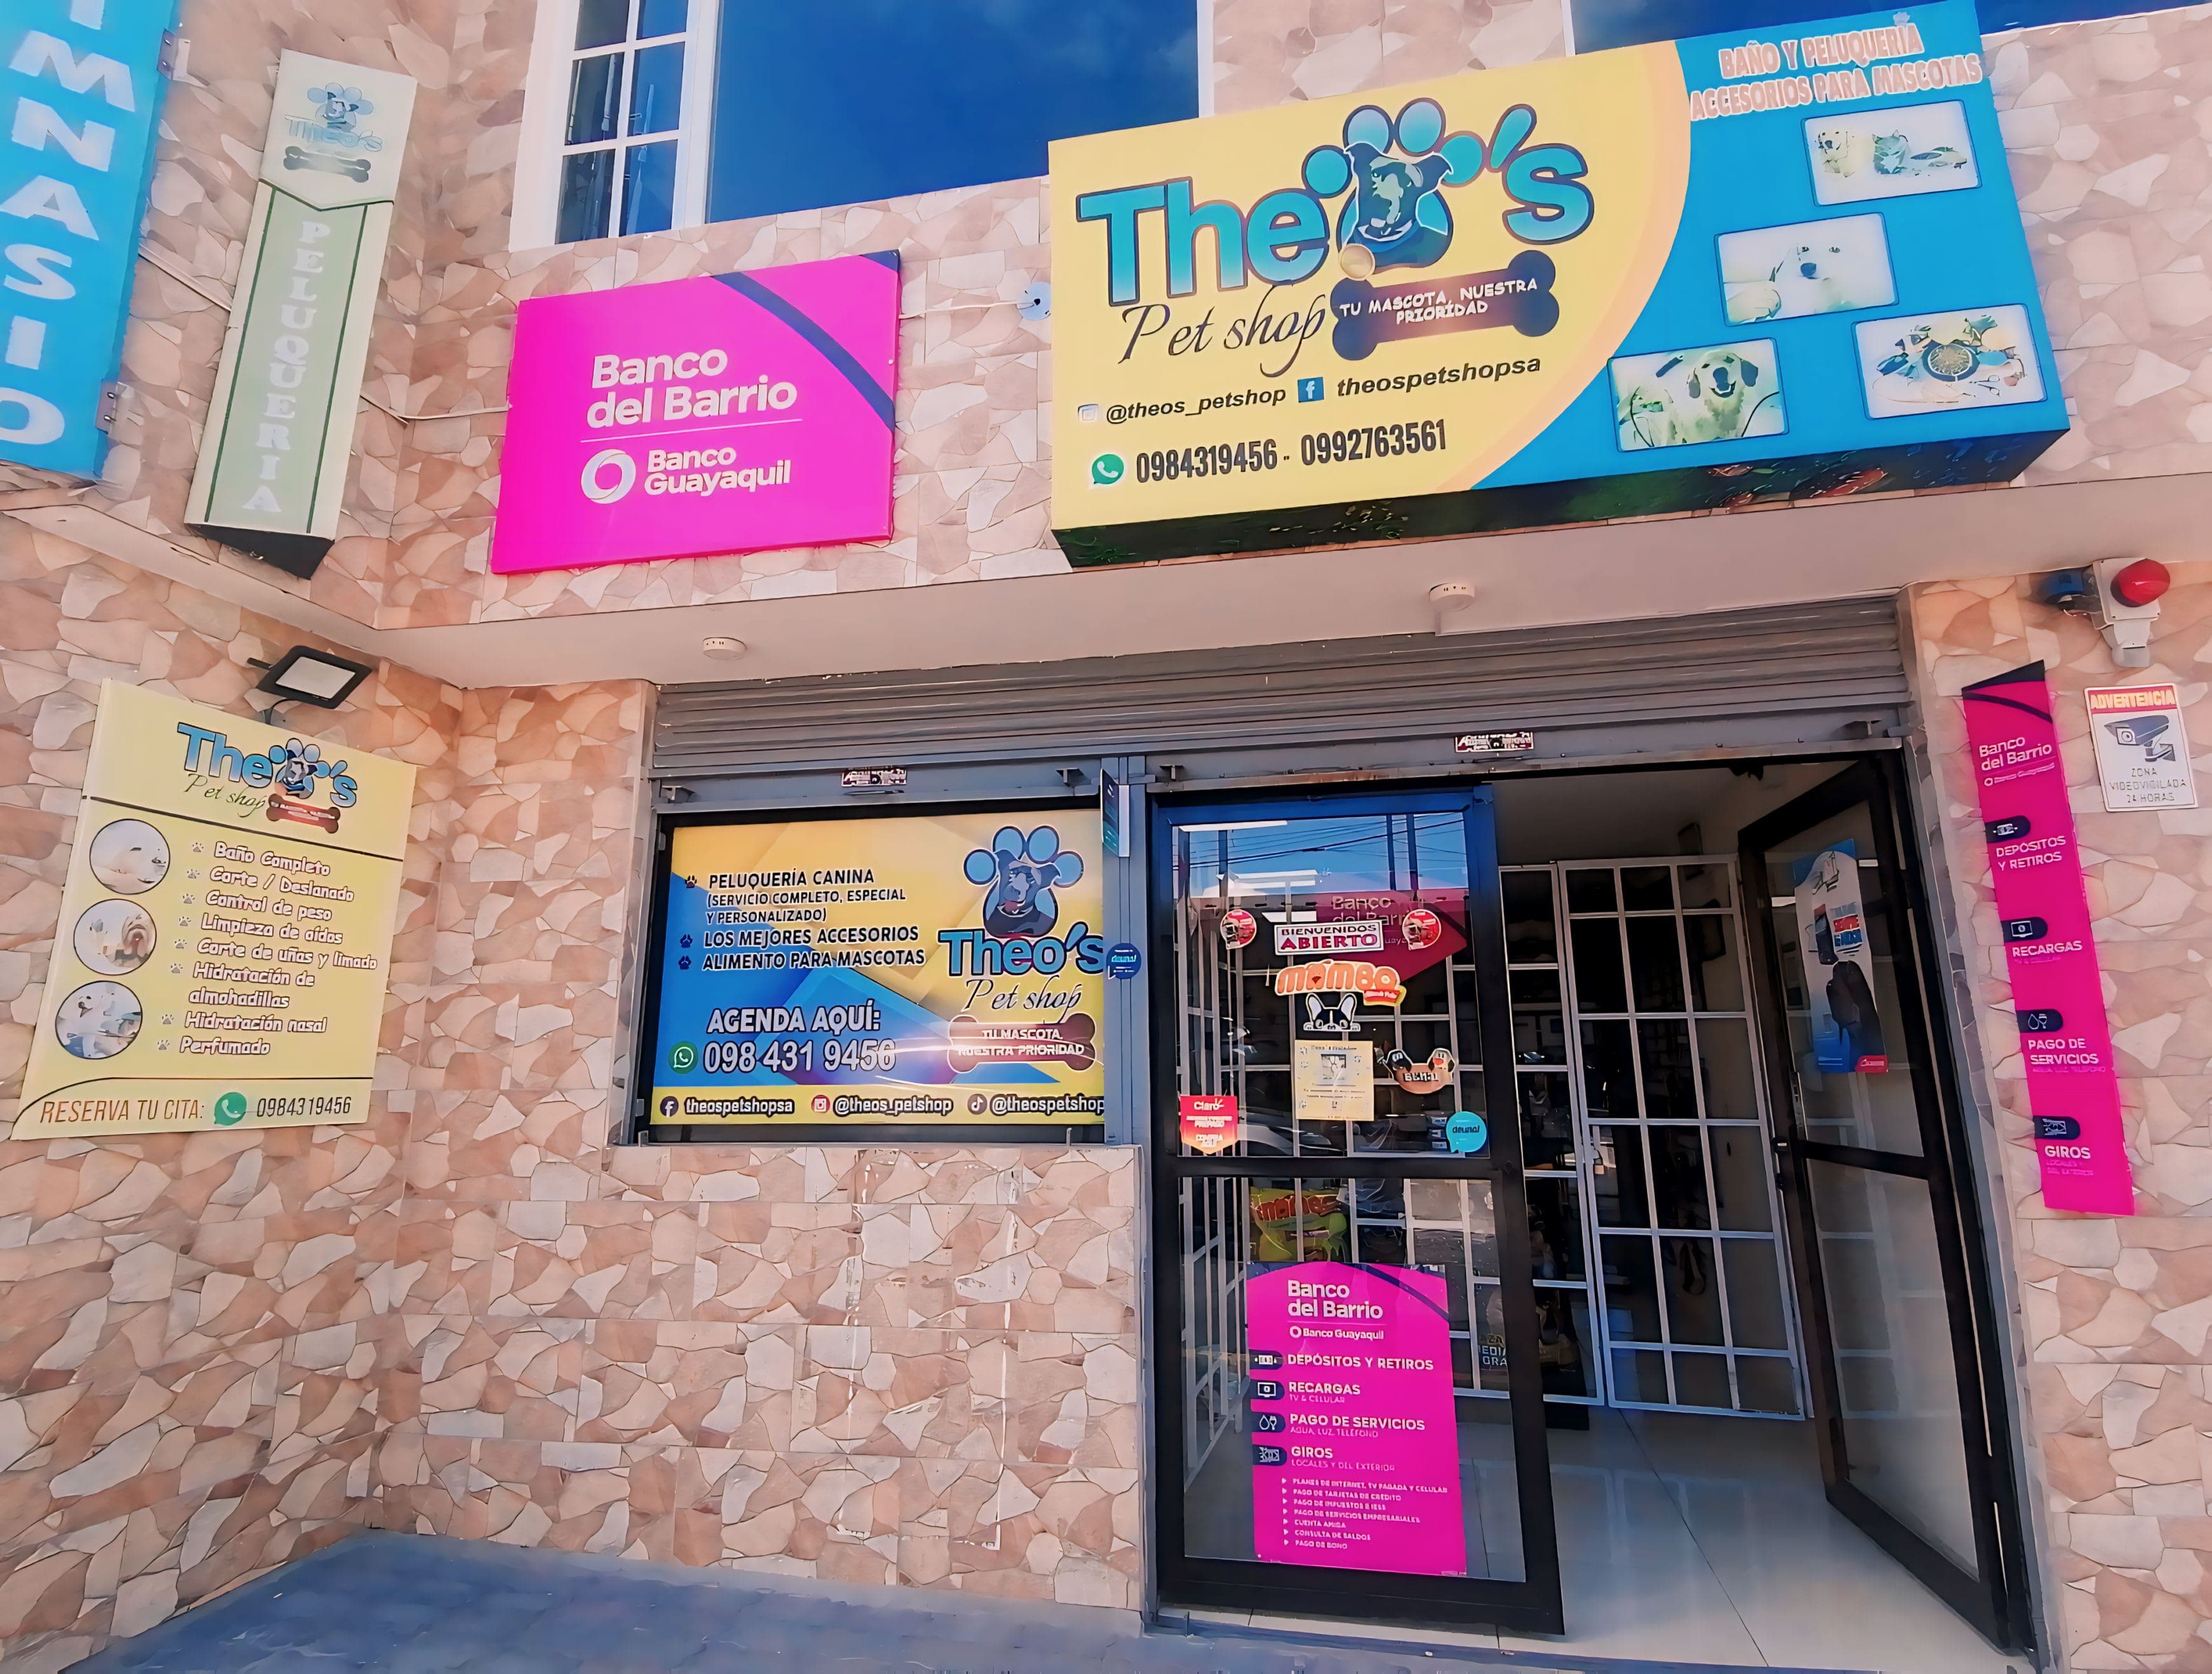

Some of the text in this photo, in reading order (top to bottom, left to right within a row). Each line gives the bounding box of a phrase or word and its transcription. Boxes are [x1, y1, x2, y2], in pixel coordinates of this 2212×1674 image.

[1718, 40, 1780, 79] BAÑO
[1781, 39, 1798, 70] Y
[1690, 53, 1982, 121] ACCESORIOS PARA MASCOTAS
[1340, 302, 1361, 317] TU
[1460, 278, 1538, 301] NUESTRA
[1397, 301, 1488, 325] PRIORIDAD
[1117, 283, 1326, 377] Pet shop
[241, 220, 331, 513] PELUQUERIA
[592, 348, 728, 389] Banco
[1337, 356, 1541, 398] theospetshopsa
[587, 374, 797, 428] del Barrio
[1106, 386, 1287, 424] @theos_petshop
[648, 447, 736, 473] Banco
[1136, 419, 1447, 483] 0984319456 0992763561
[644, 460, 790, 496] Guayaquil
[2089, 689, 2176, 709] ADVERTENCIA
[1979, 737, 2025, 758] Banco
[1981, 743, 2052, 771] del Barrio
[2131, 767, 2158, 777] ZONA
[184, 773, 222, 799] Pet
[227, 786, 266, 817] shop
[2141, 792, 2176, 802] HORAS
[214, 842, 330, 875] Baño Completo
[1998, 851, 2062, 871] Y RETIROS
[210, 867, 258, 887] Corte
[280, 876, 354, 901] Deslanado
[709, 868, 874, 889] PELUQUERÍA CANINA
[206, 890, 332, 921] Control de peso
[707, 889, 906, 908] (SERVICIO COMPLETO, ESPECIAL
[1332, 896, 1391, 910] Banco
[201, 912, 273, 936] Limpieza
[280, 923, 299, 940] de
[707, 908, 827, 924] Y PERSONALIZADO)
[705, 926, 919, 948] LOS MEJORES ACCESORIOS
[1280, 934, 1378, 950] ABIERTO
[197, 938, 377, 969] Corte de uñas y limado
[938, 921, 1104, 976] Theo's
[2012, 940, 2083, 957] RECARGAS
[702, 950, 925, 970] ALIMENTO PARA MASCOTAS
[193, 961, 315, 986] Hidratación de
[189, 987, 289, 1008] almohadillas
[961, 975, 1082, 1024] Pet shop
[185, 1011, 327, 1032] Hidratación nasal
[706, 999, 881, 1035] AGENDA AQUÍ:
[180, 1036, 270, 1055] Perfumado
[1019, 1044, 1085, 1056] PRIORIDAD
[2028, 1038, 2086, 1050] PAGO DE
[703, 1039, 897, 1073] 098 431 9456
[2030, 1053, 2099, 1065] SERVICIOS
[40, 1097, 352, 1123] RESERVA TU CITA: 0984319456
[685, 1094, 1104, 1117] theospetshopsa @theos_petshop @theospetshop
[1194, 1098, 1225, 1110] Claro
[2044, 1145, 2091, 1159] GIROS
[1288, 1280, 1350, 1297] Banco
[1287, 1299, 1383, 1319] del Barrio
[1303, 1328, 1384, 1340] Banco Guayaquil
[1287, 1353, 1434, 1370] DEPÓSITOS Y RETIROS
[1289, 1382, 1360, 1395] RECARGAS
[1290, 1413, 1425, 1430] PAGO DE SERVICIOS
[1291, 1446, 1333, 1459] GIROS
